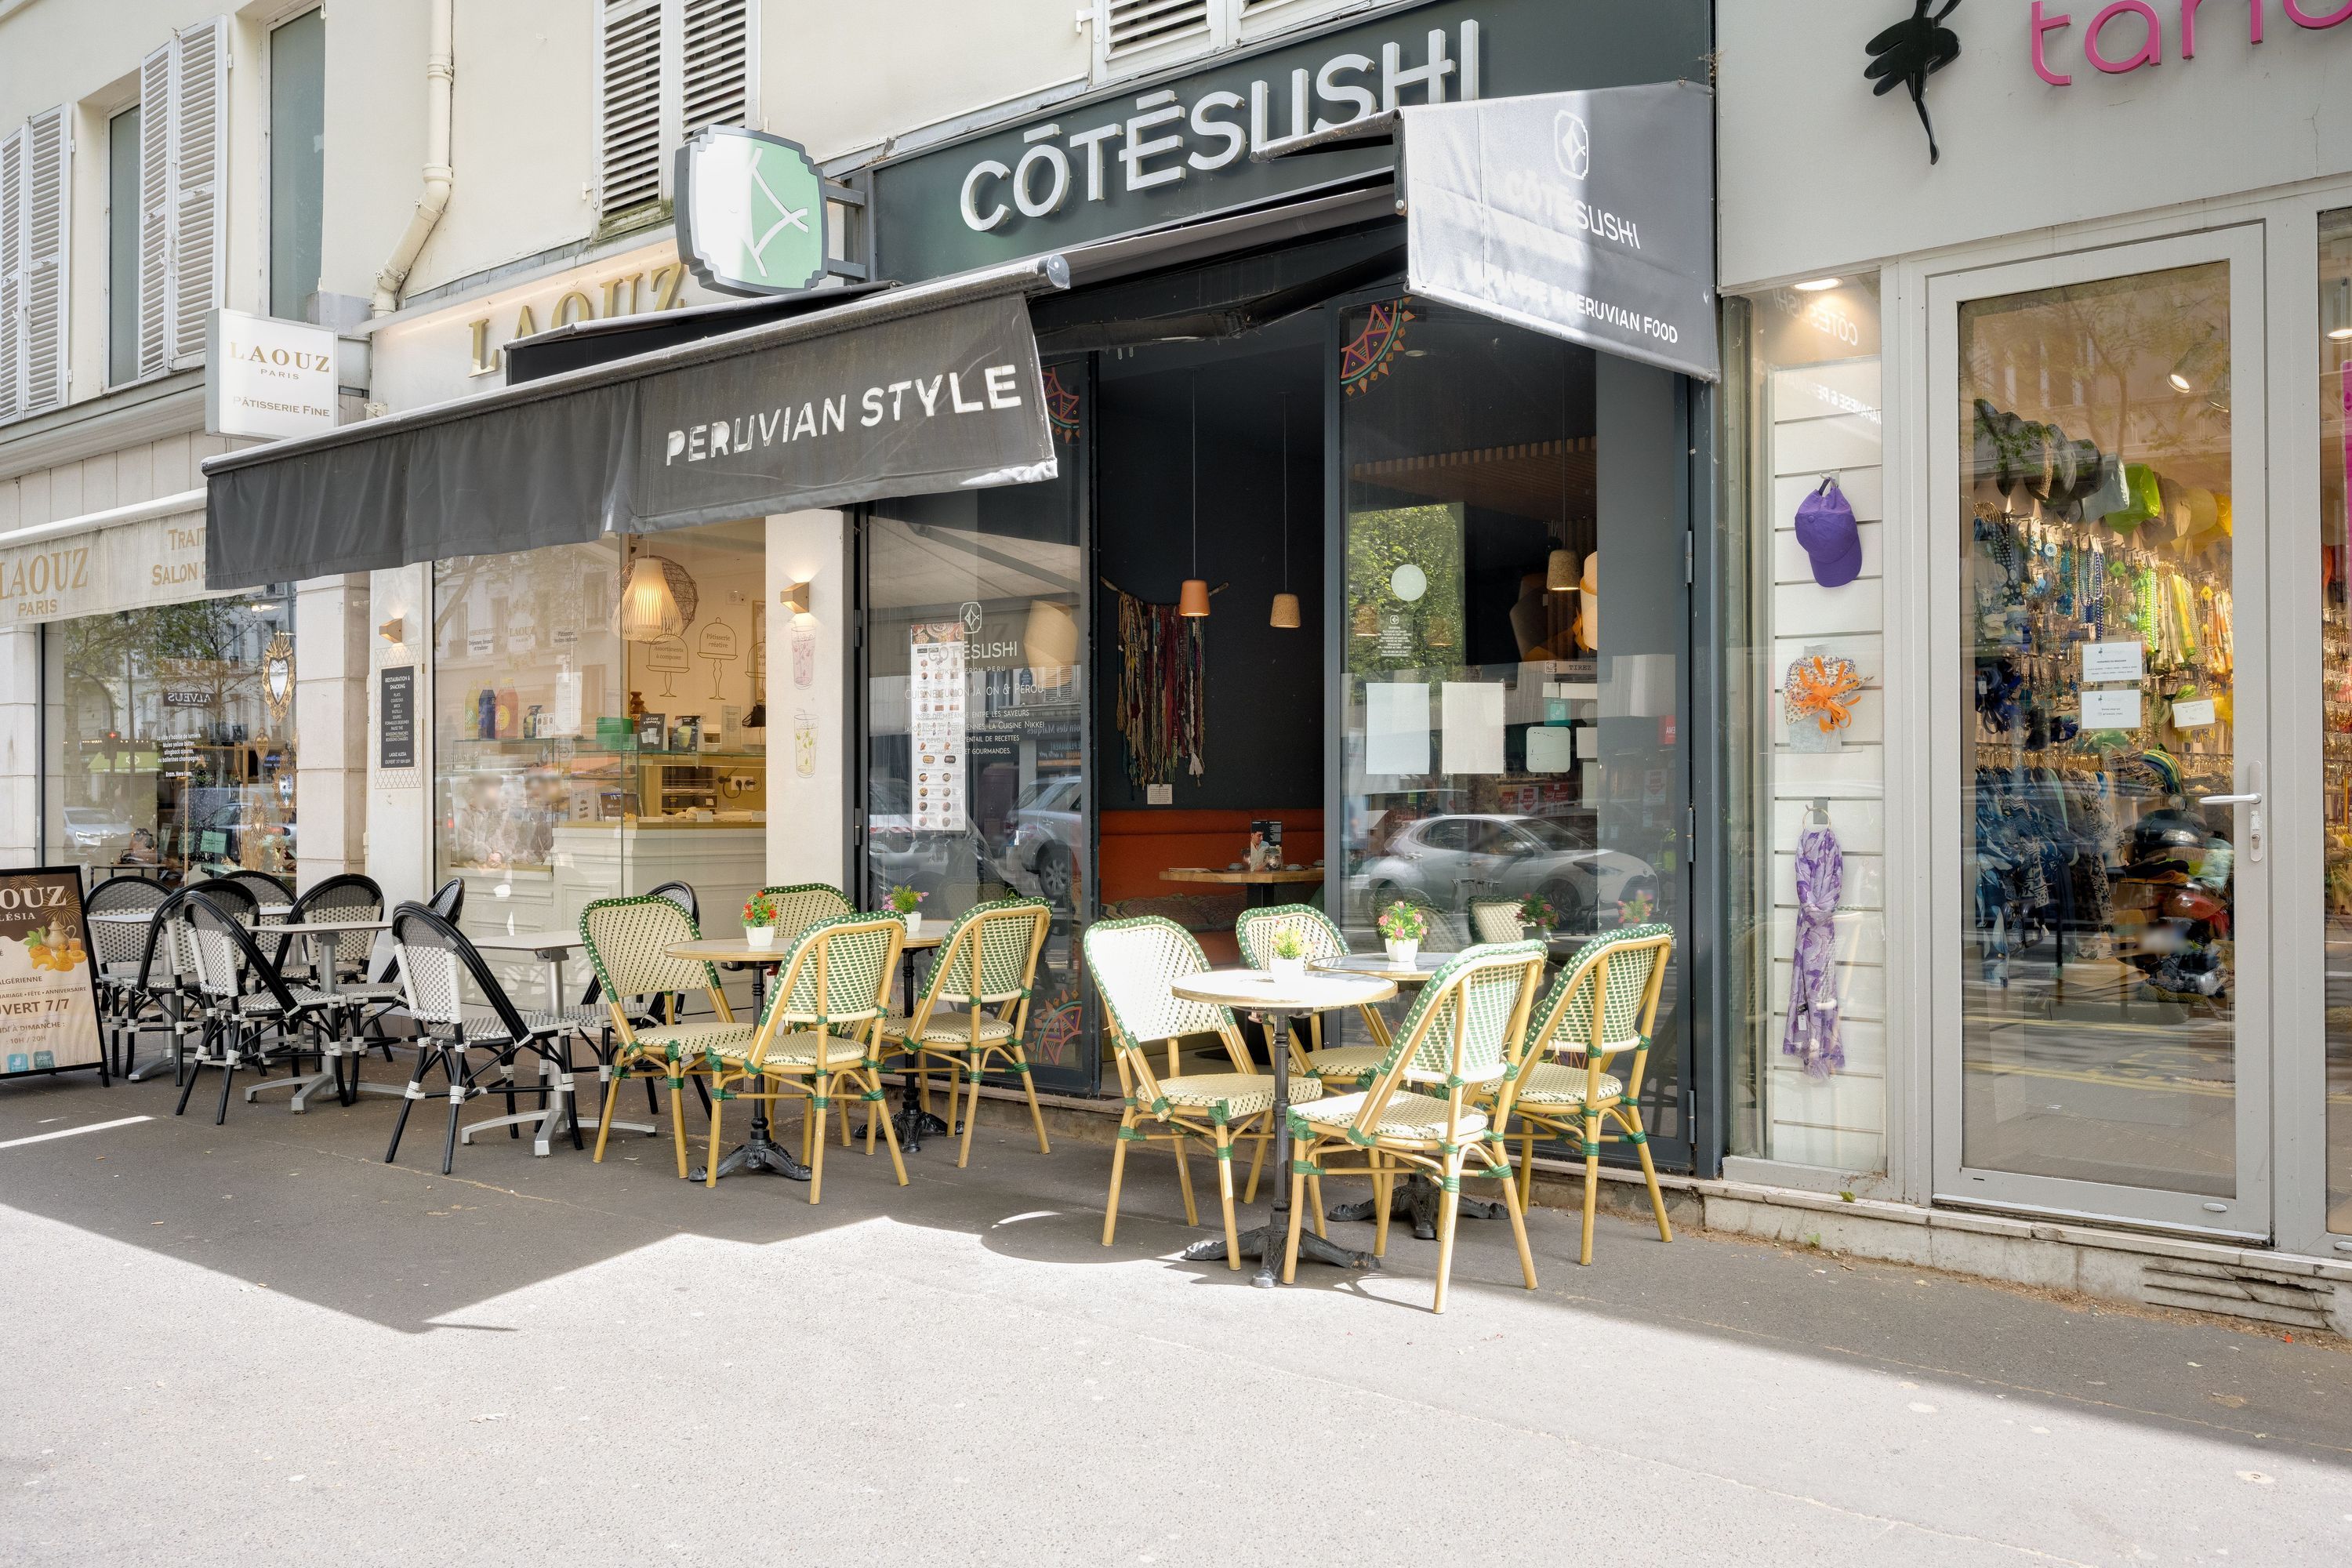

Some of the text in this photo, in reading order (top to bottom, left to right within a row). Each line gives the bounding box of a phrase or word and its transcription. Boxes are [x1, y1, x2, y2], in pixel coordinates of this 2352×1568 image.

[1643, 316, 1679, 344] FOOD
[230, 341, 330, 373] LAOUZ
[260, 368, 299, 380] PARIS
[233, 395, 330, 417] PÂTISSERIE FINE
[666, 364, 1022, 466] PERUVIAN STYLE
[0, 547, 89, 600] LAOUZ
[152, 562, 198, 586] SALON
[18, 599, 57, 616] PARIS
[706, 633, 731, 641] Pâtisserie
[905, 689, 938, 700] CUINE
[971, 684, 1000, 696] JAON
[1003, 683, 1011, 695] &
[1014, 682, 1044, 694] PÉROU
[0, 885, 67, 909] OUZ
[45, 986, 87, 995] ANNIVERSAIRE
[0, 998, 70, 1015] VERT 7/7
[20, 1022, 61, 1032] DIMANCHE
